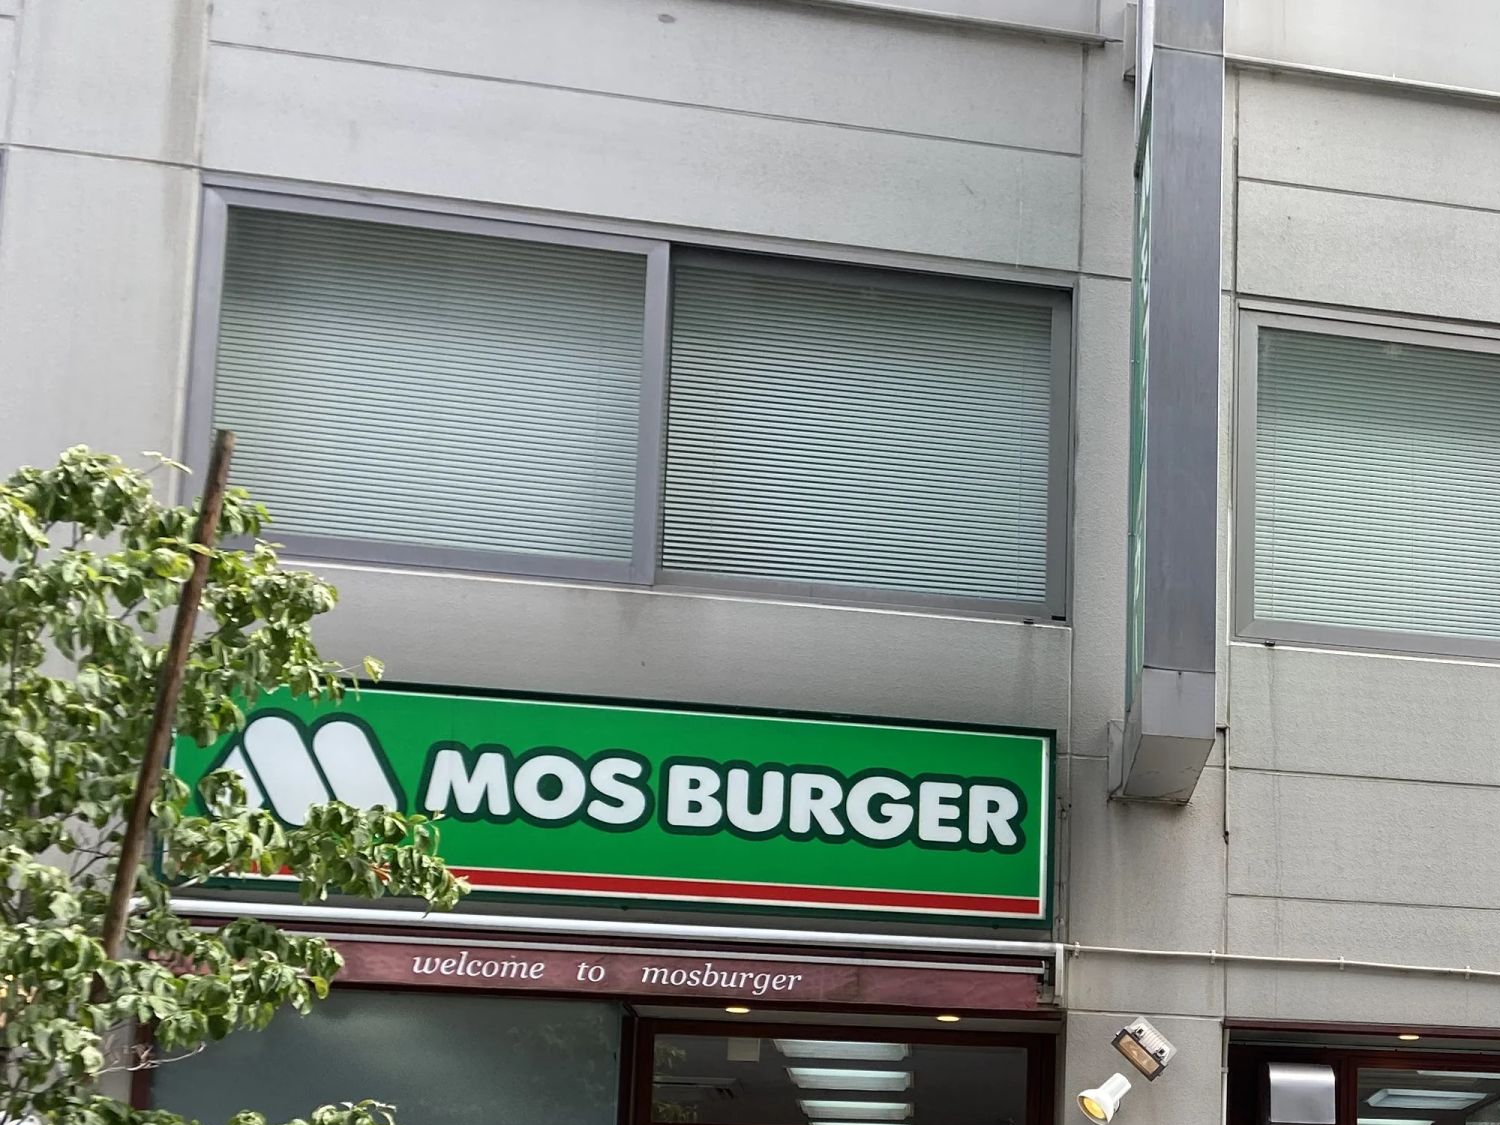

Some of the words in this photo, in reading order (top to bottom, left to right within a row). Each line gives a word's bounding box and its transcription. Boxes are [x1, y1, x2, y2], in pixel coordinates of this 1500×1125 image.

[423, 749, 646, 825] MOS
[666, 764, 1019, 846] BURGER
[411, 951, 546, 980] welcome
[575, 960, 606, 982] to
[640, 963, 803, 996] mosburger
